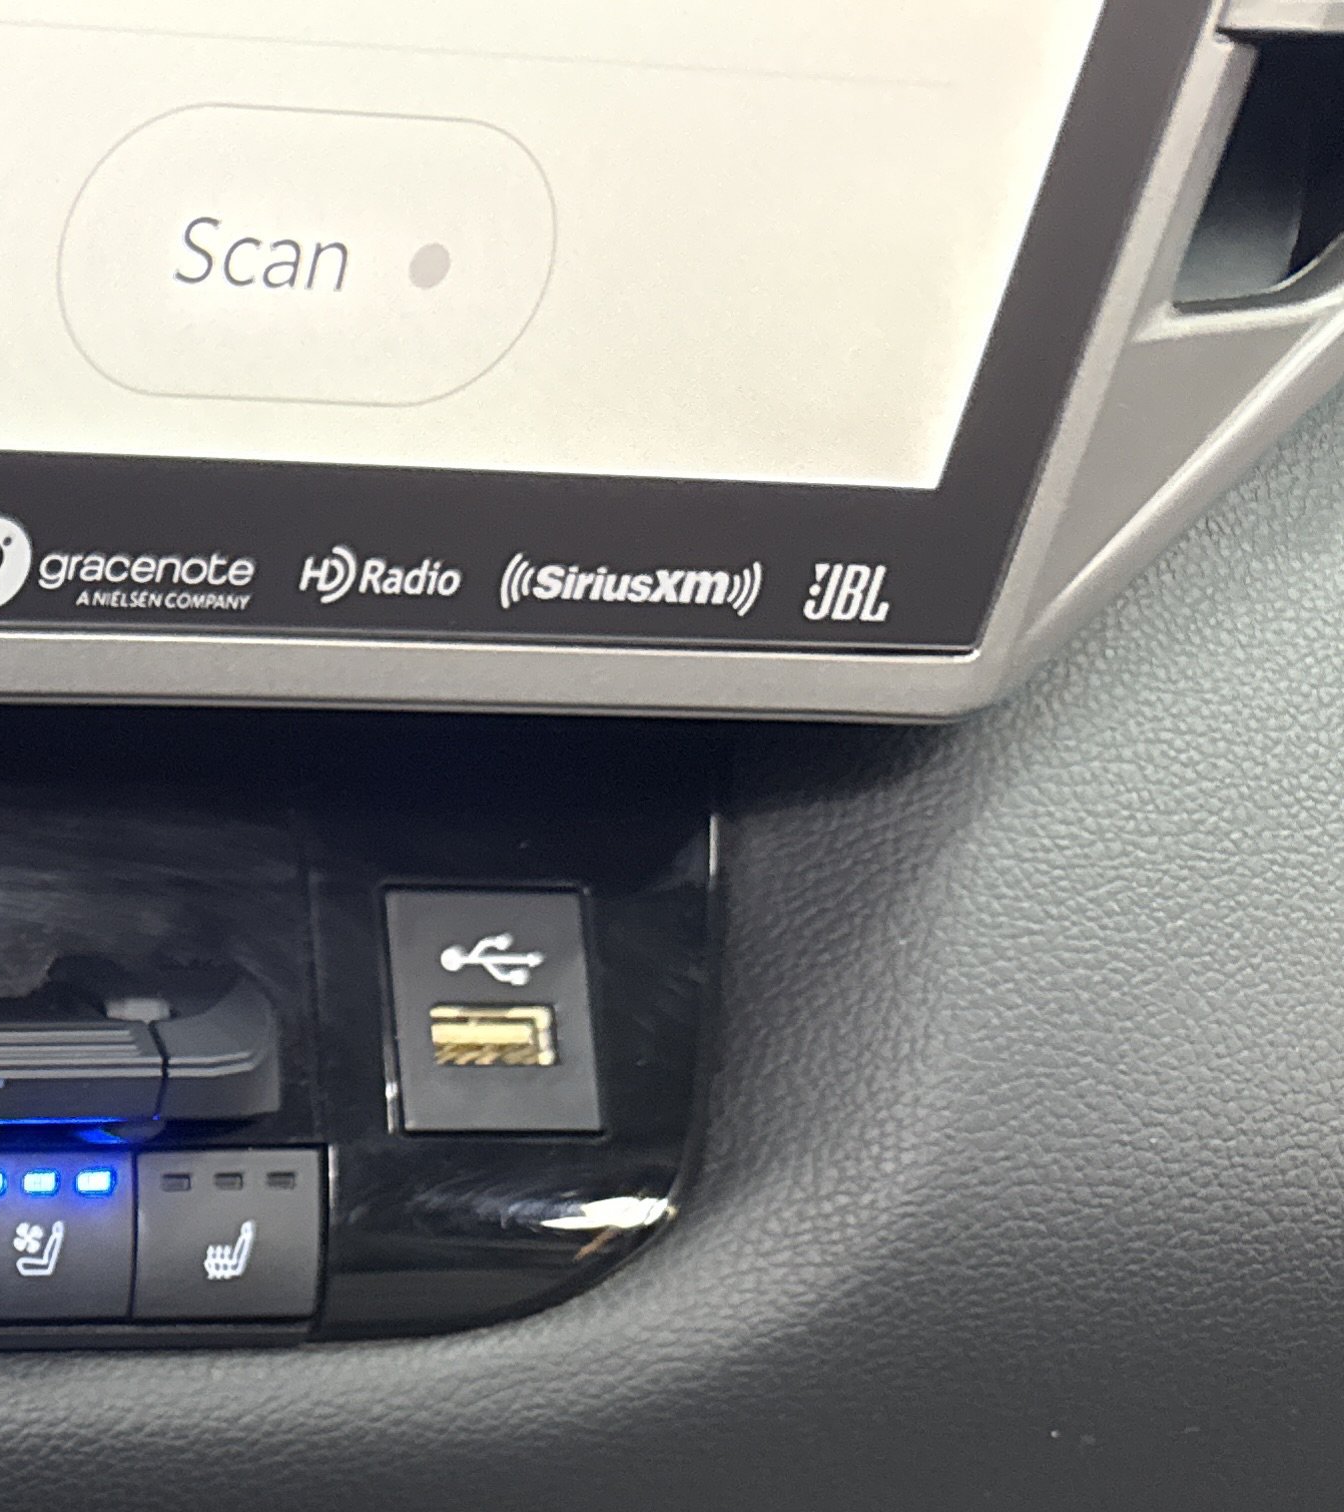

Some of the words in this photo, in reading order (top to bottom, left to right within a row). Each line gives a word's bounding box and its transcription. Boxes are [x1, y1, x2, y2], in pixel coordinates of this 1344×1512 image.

[174, 216, 350, 292] Scan
[38, 552, 256, 590] gracenote
[359, 558, 462, 598] Radio
[91, 591, 163, 610] NIELSEN
[163, 592, 252, 612] COMPANY
[805, 563, 890, 622] JBL
